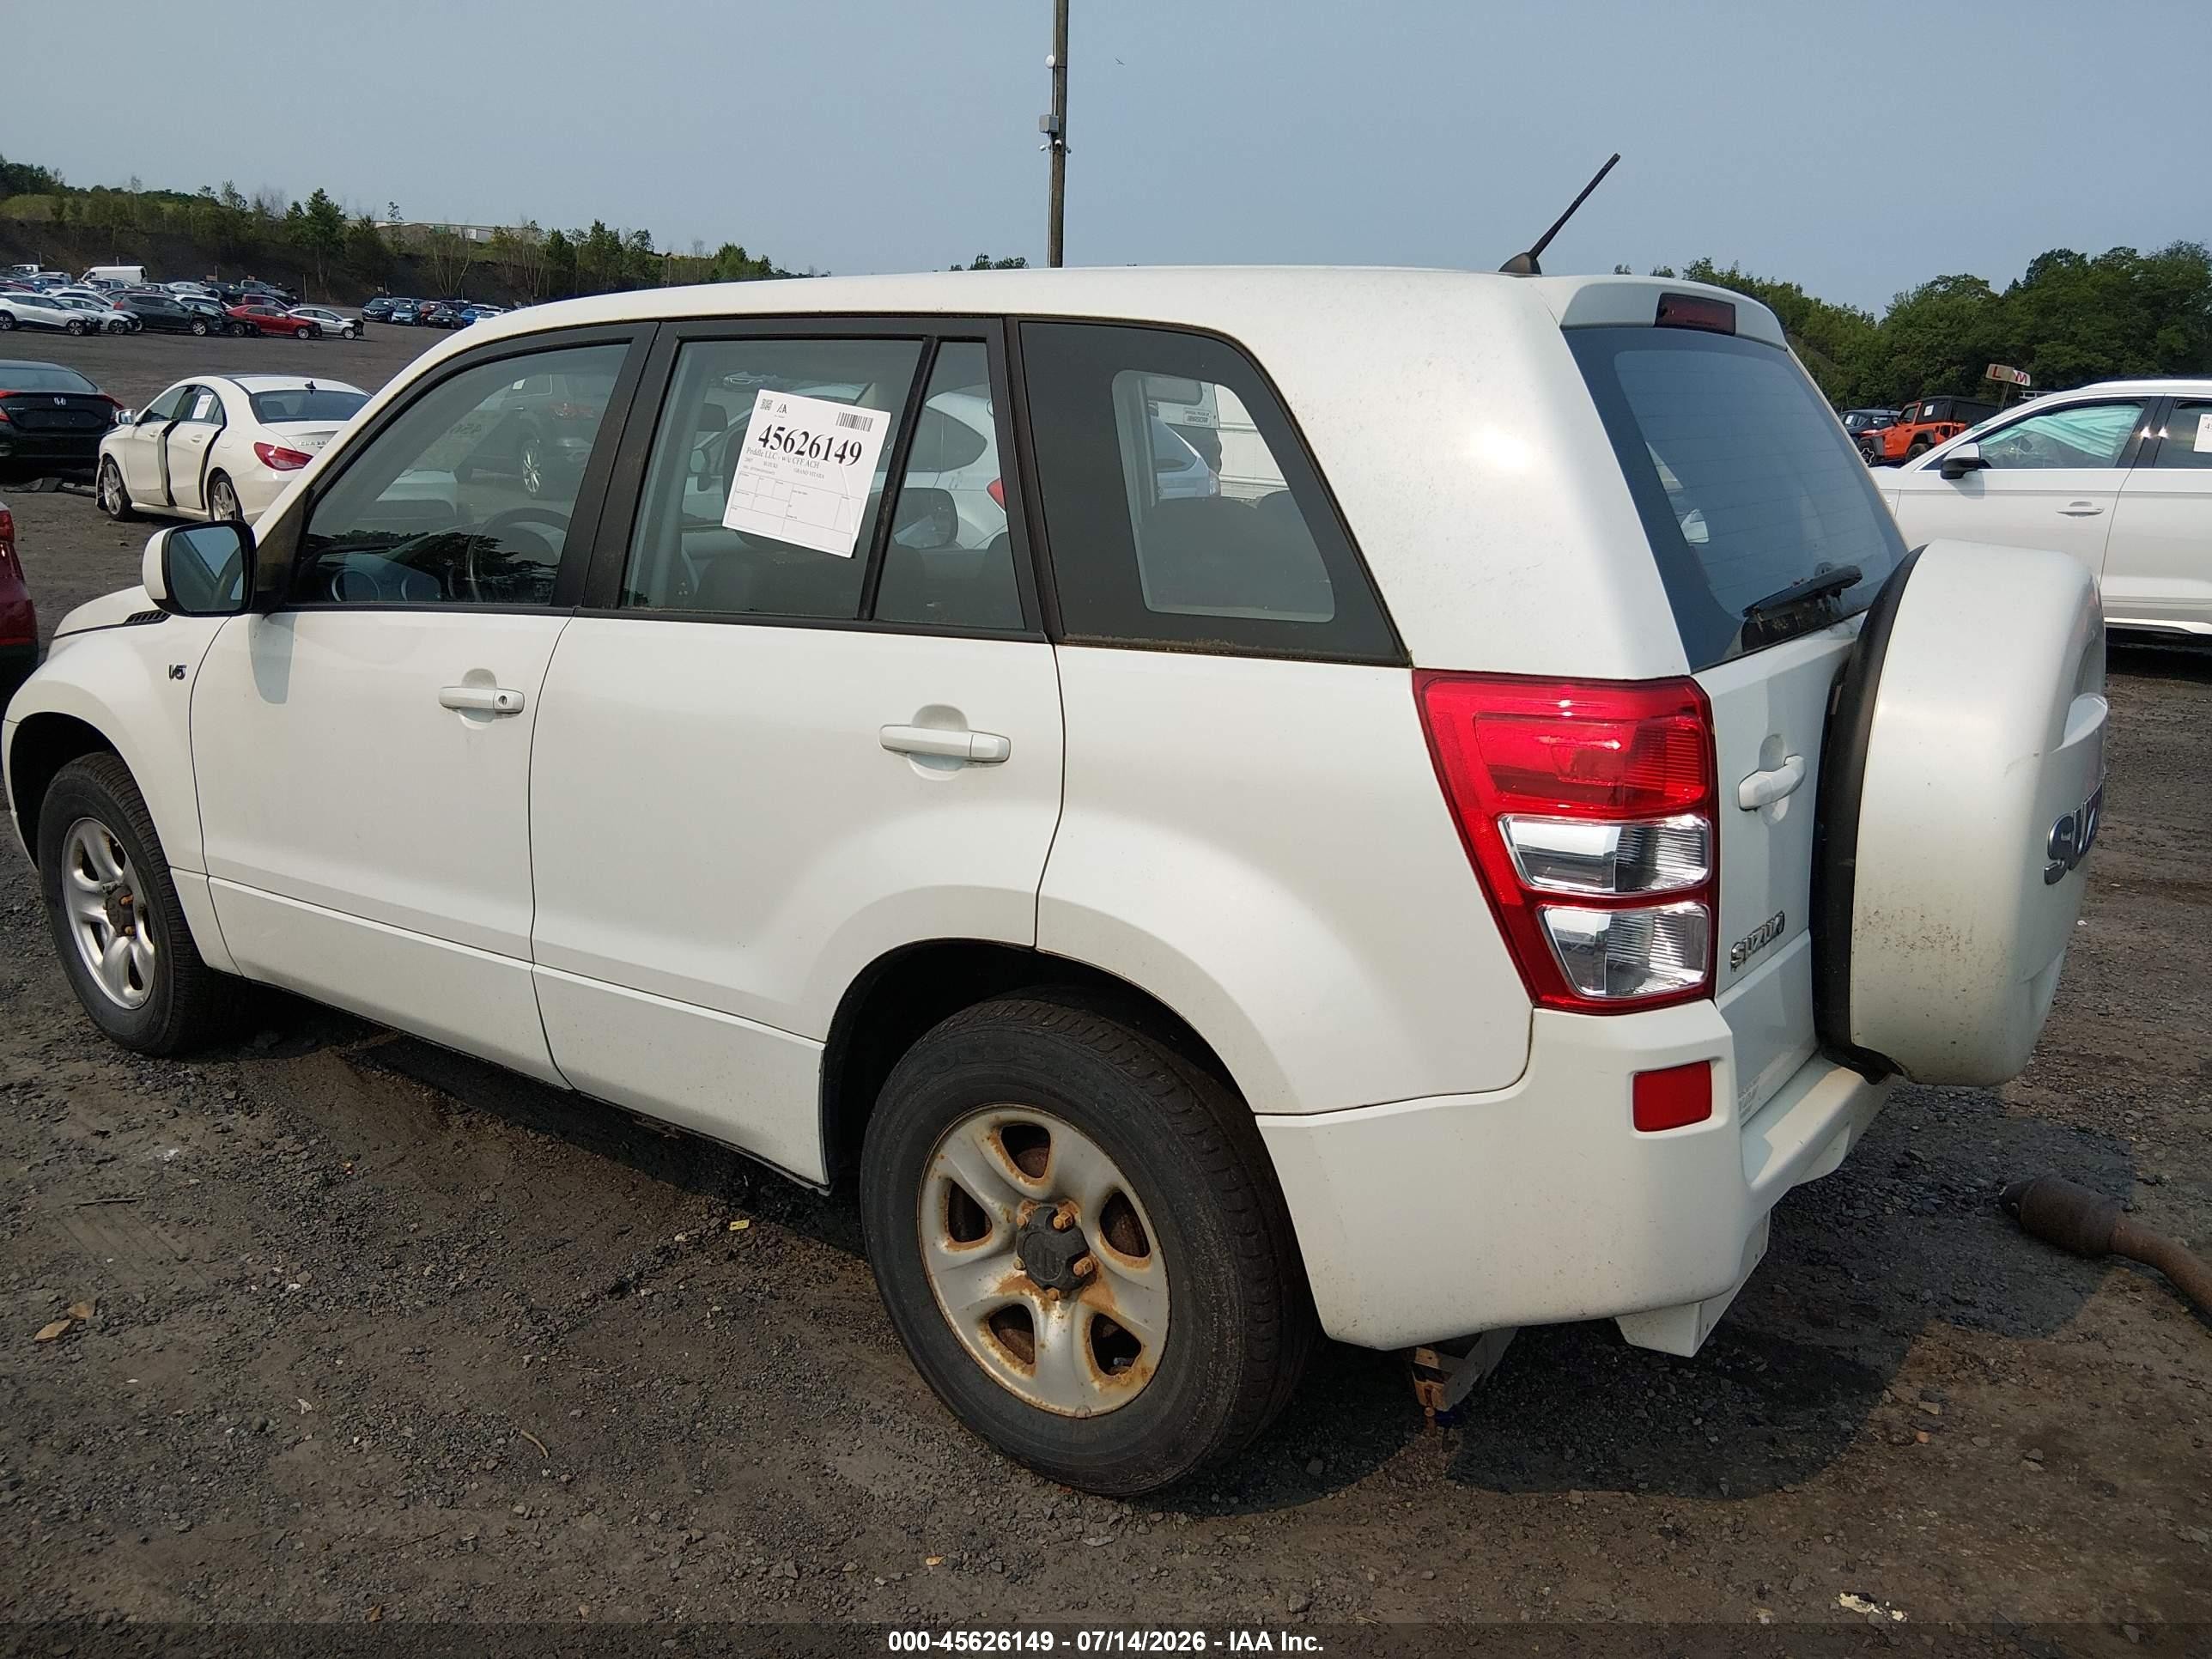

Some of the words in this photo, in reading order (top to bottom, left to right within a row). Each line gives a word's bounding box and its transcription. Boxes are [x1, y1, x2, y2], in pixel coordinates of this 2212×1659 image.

[1992, 366, 2001, 378] L
[758, 424, 862, 466] 45626149
[745, 447, 764, 458] Peddle
[764, 451, 779, 460] LLC
[793, 467, 809, 476] GRAND
